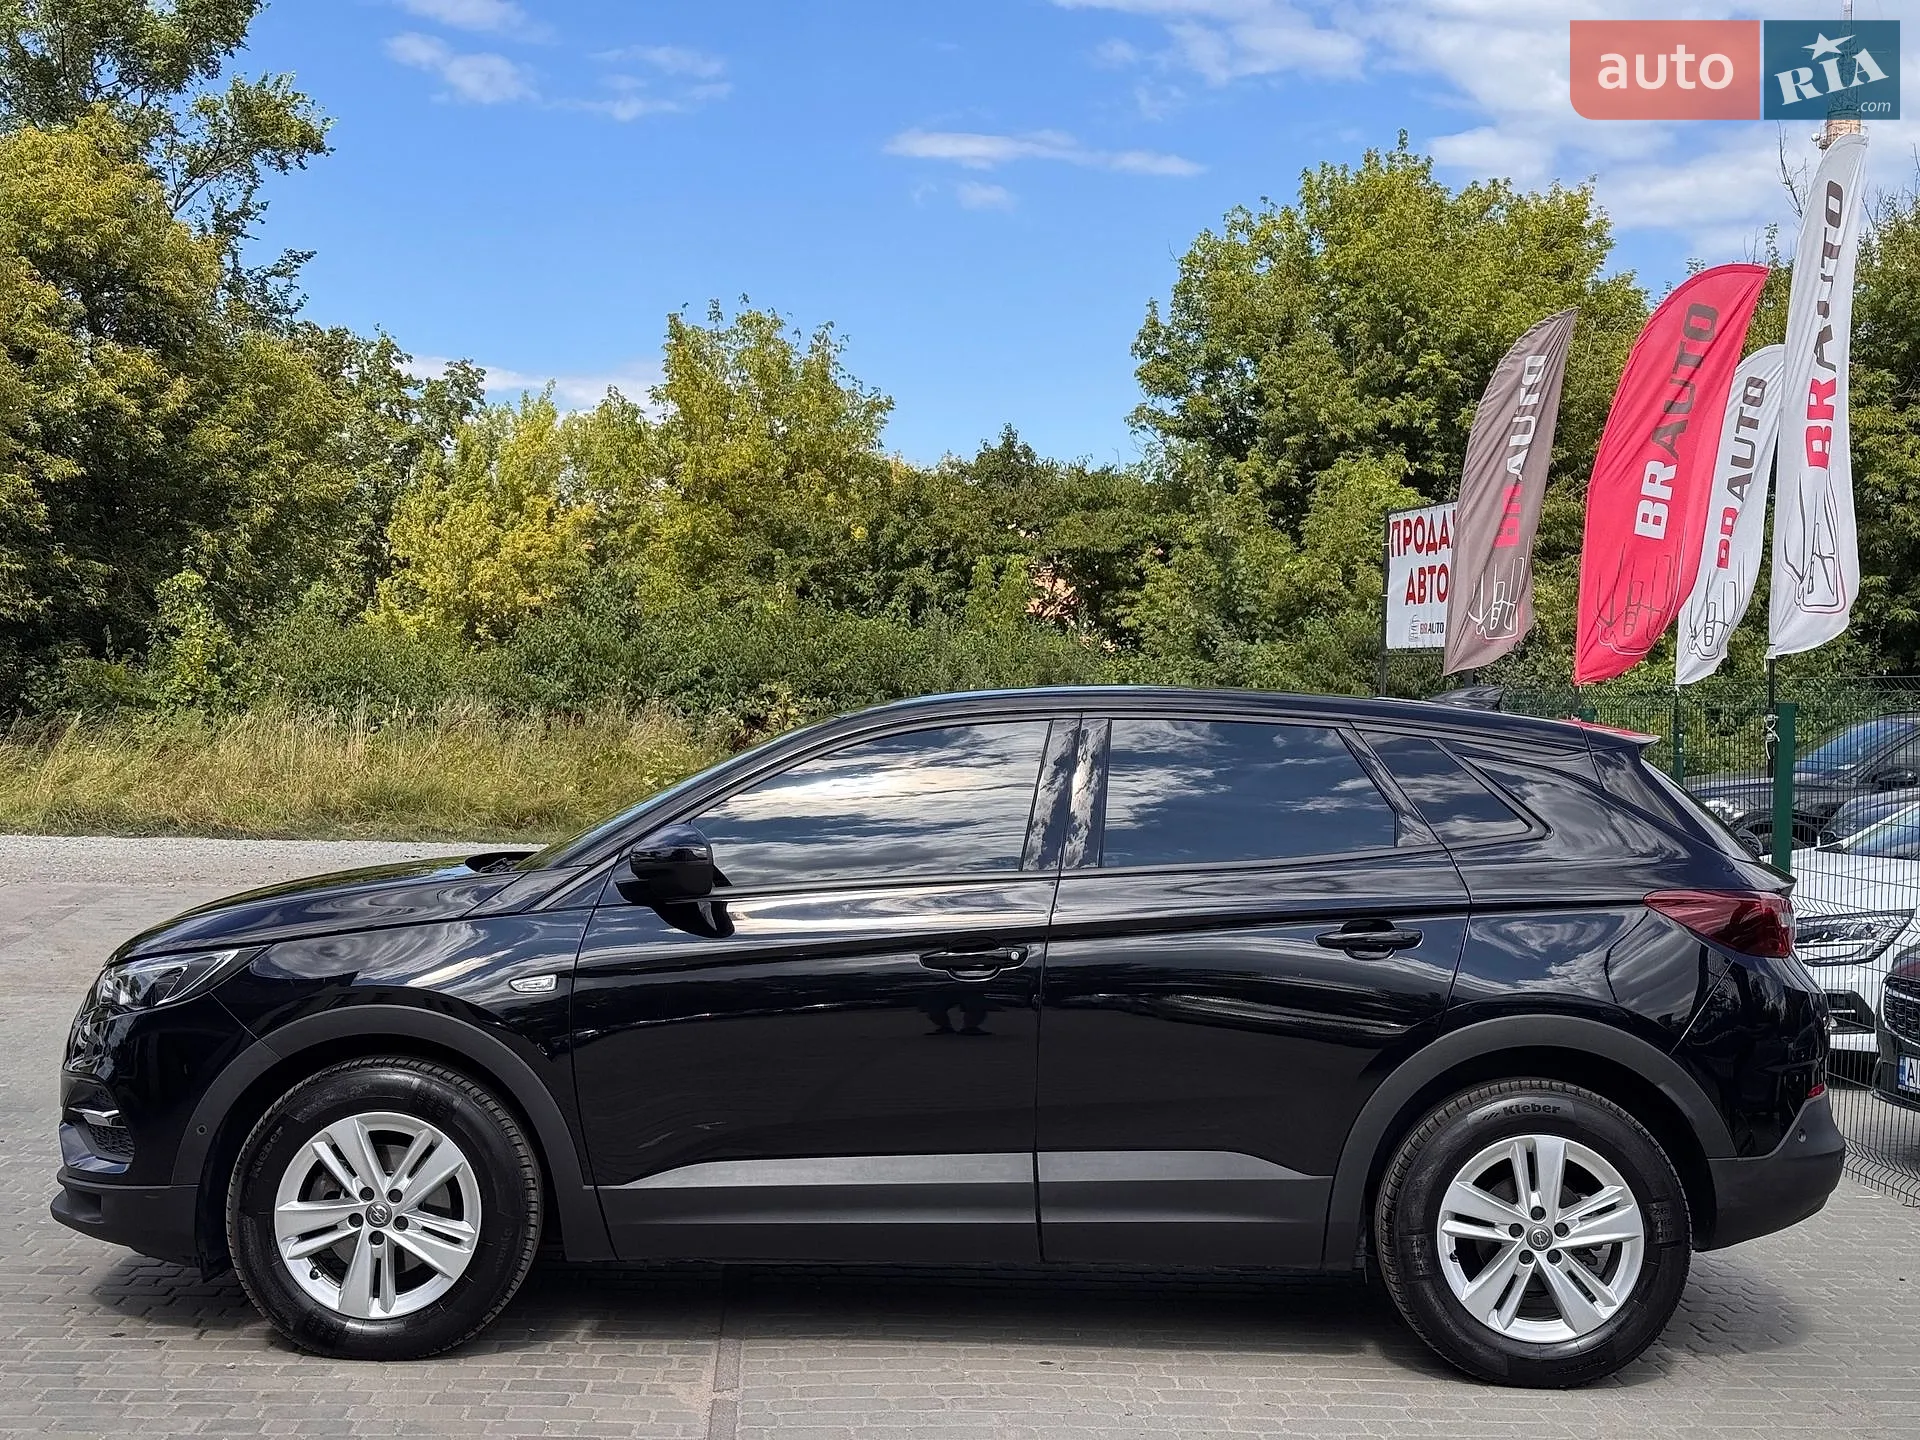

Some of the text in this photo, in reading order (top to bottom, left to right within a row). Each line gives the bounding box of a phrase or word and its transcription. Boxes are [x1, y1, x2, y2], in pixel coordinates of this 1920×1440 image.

[1634, 302, 1720, 540] BRAUTO
[1390, 509, 1457, 558] ПРОДА
[1405, 562, 1450, 606] АВТО
[1419, 621, 1445, 635] BRAUTO
[1503, 1103, 1561, 1117] Kleber
